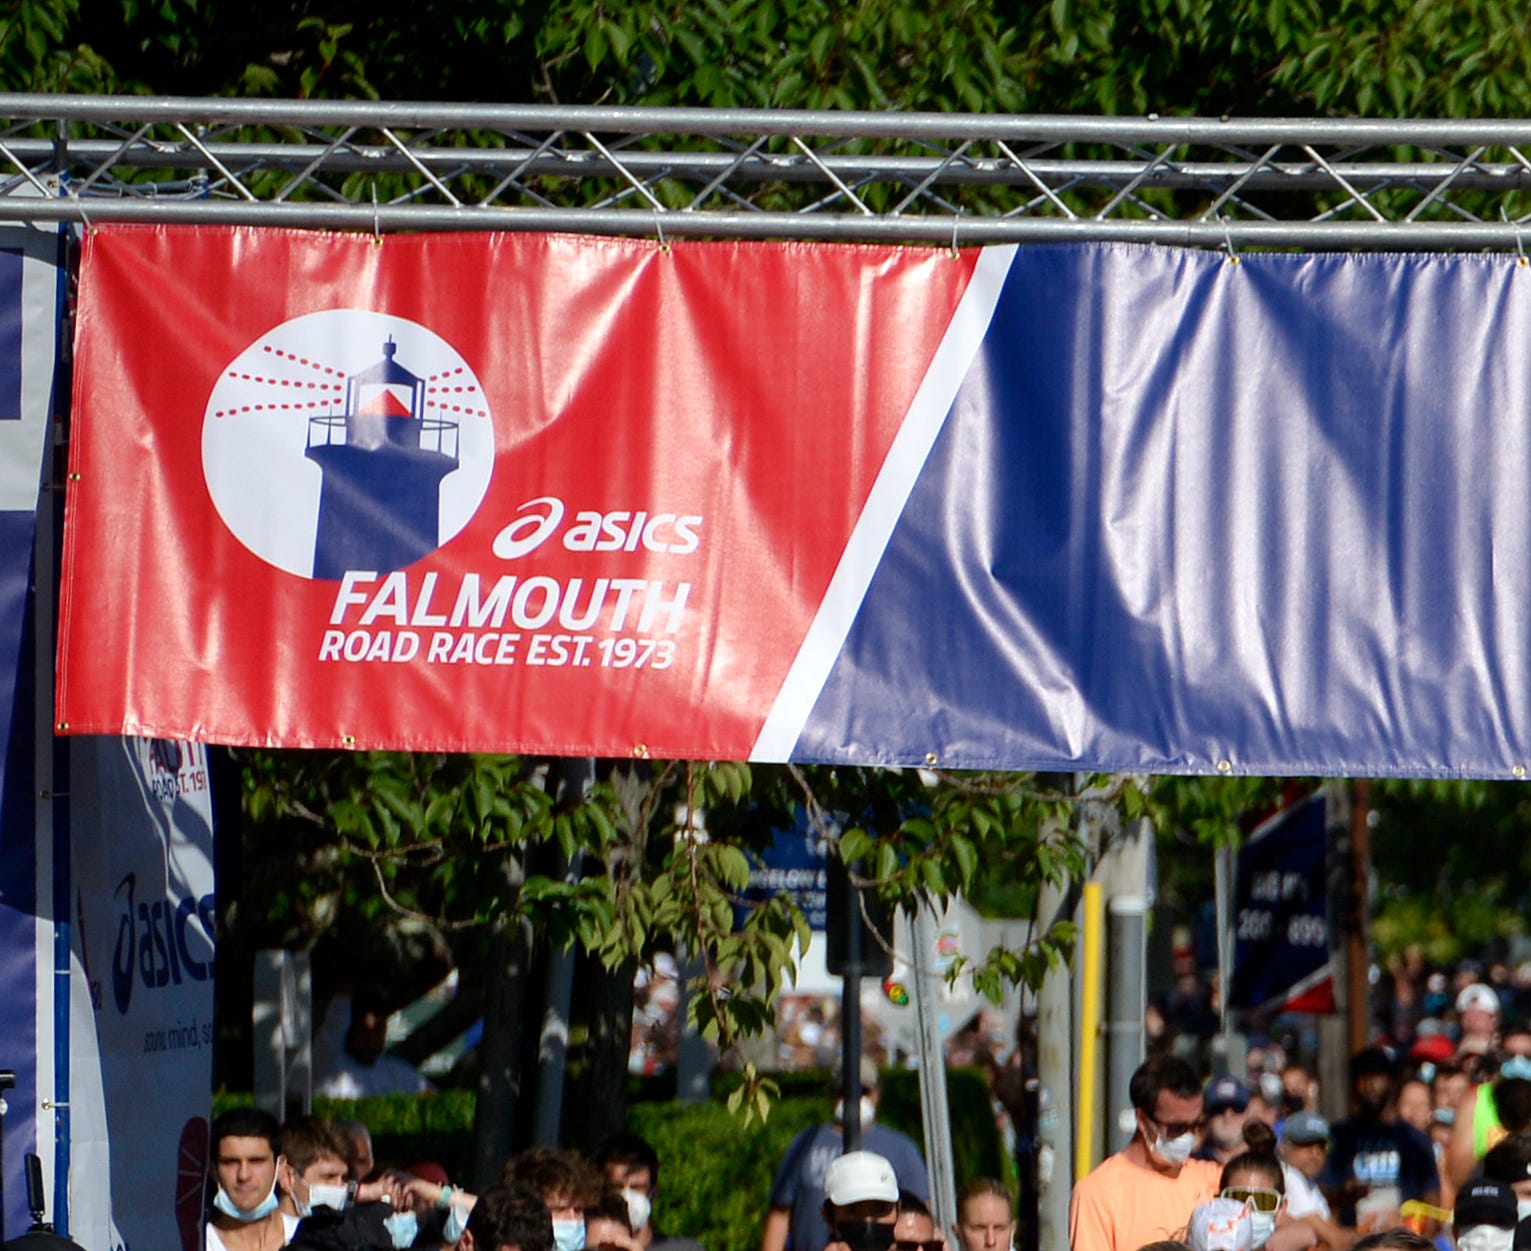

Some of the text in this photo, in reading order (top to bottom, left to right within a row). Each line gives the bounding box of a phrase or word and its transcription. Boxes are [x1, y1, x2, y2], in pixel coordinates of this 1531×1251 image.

[563, 511, 703, 555] asics
[329, 570, 691, 634] FALMOUTH
[318, 630, 675, 670] ROAD RACE EST. 1973
